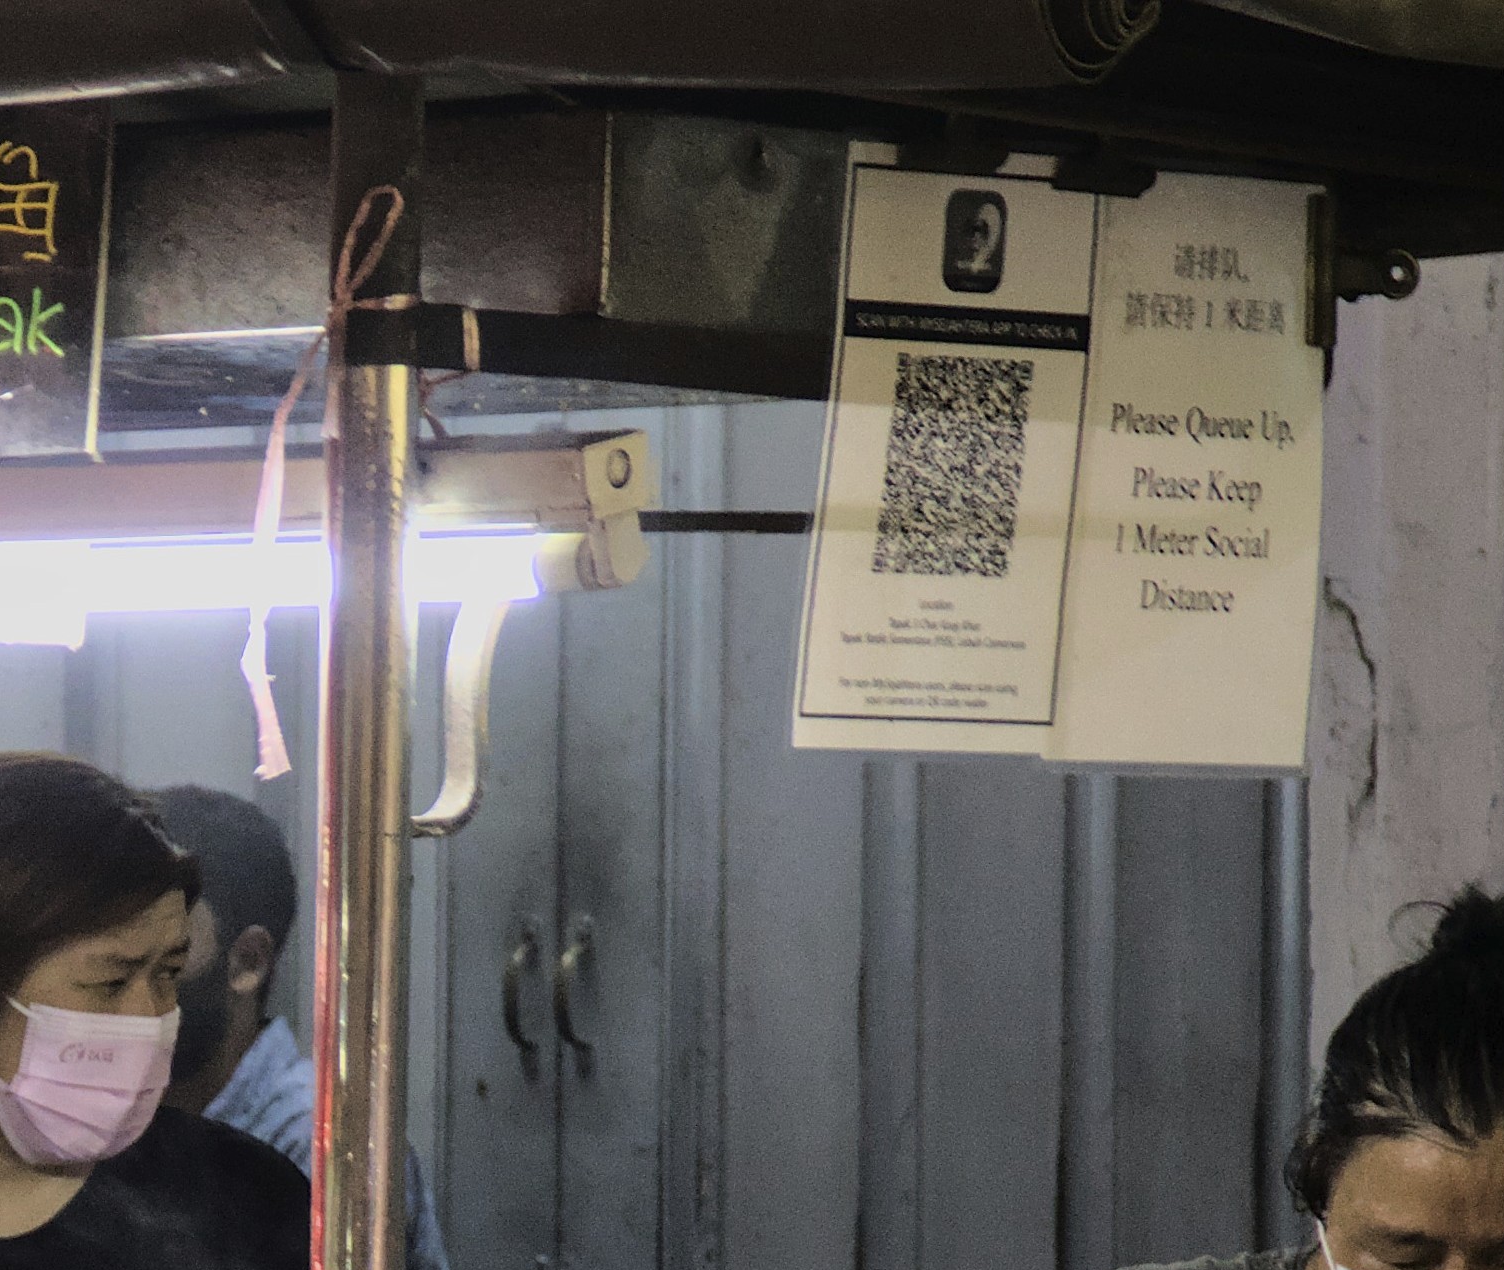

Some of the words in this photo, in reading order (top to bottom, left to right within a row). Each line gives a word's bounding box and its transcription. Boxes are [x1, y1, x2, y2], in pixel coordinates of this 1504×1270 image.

[1110, 402, 1180, 436] Please
[1185, 406, 1254, 445] Queue
[1260, 409, 1296, 451] Up.
[1132, 466, 1201, 500] Please
[1207, 470, 1263, 512] Keep
[1116, 522, 1125, 554] 1
[1132, 523, 1199, 556] Meter
[1203, 525, 1270, 559] Social
[1141, 578, 1235, 613] Distance
